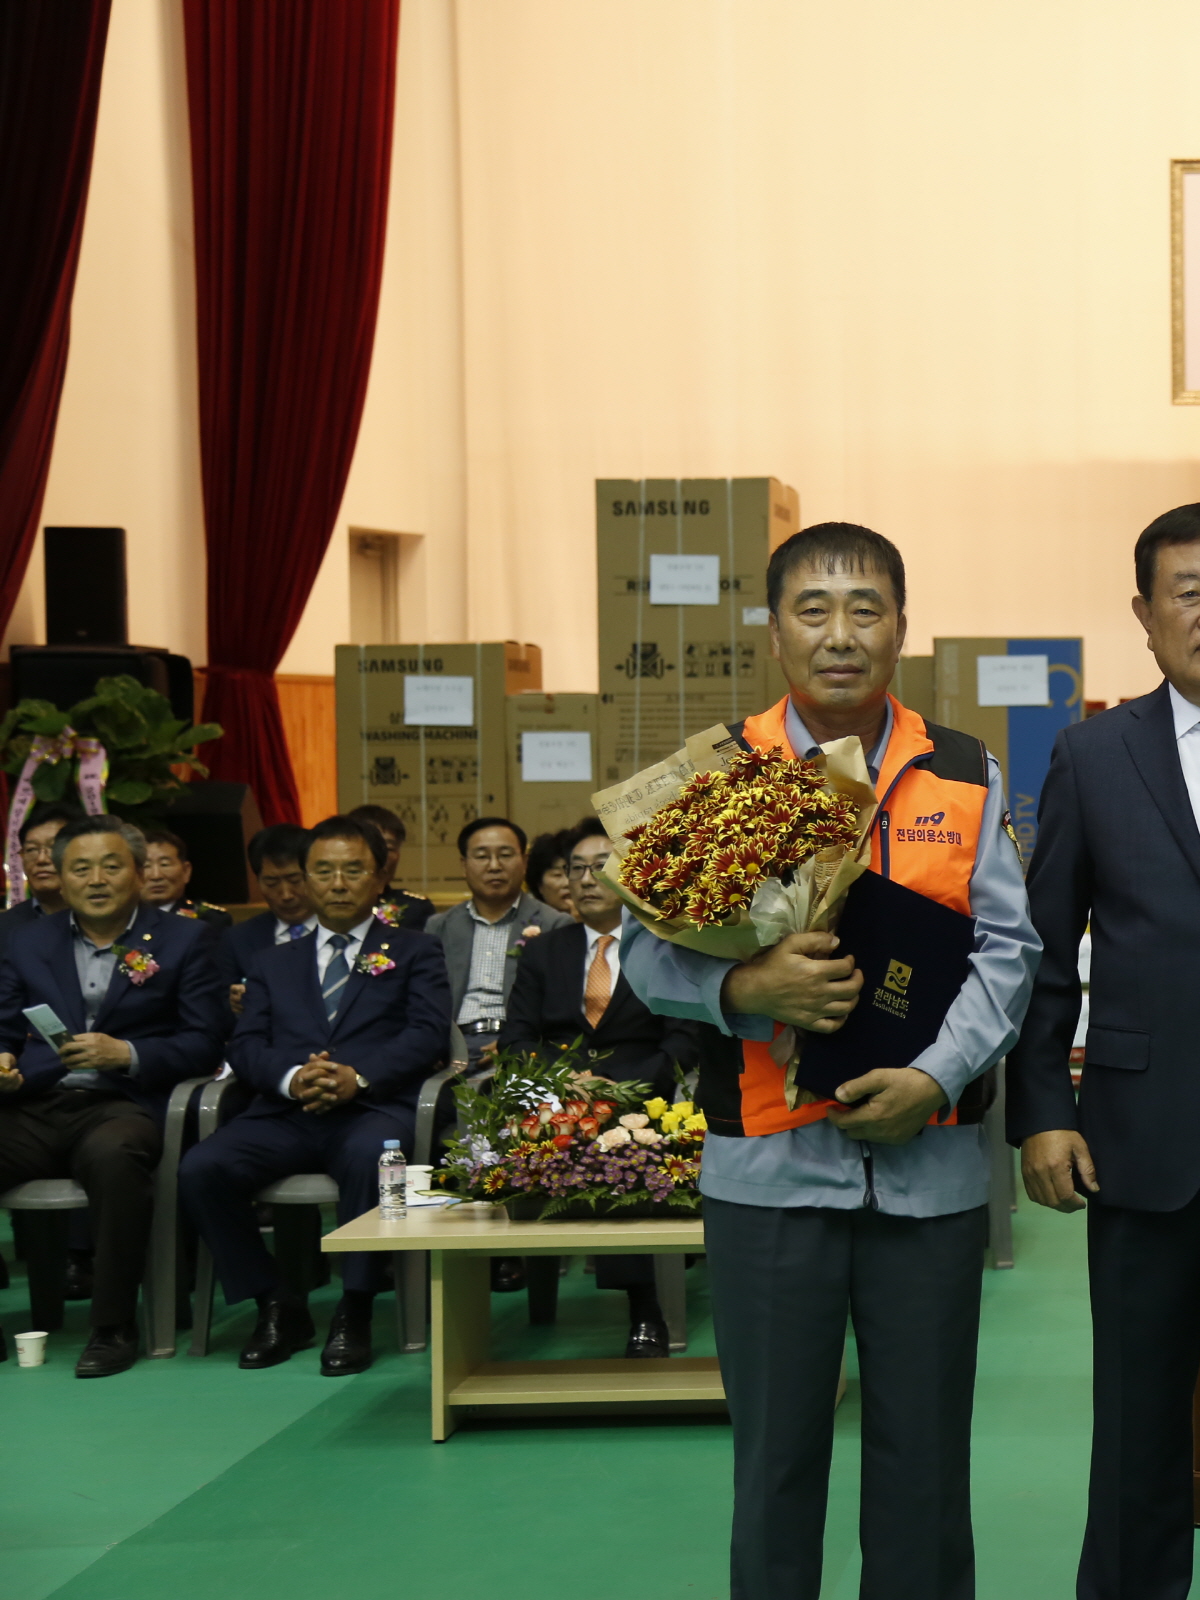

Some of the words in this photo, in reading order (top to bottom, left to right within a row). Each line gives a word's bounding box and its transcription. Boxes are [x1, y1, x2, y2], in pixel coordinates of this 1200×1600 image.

[612, 500, 710, 516] SAMSUNG
[358, 658, 443, 673] SAMSUNG
[360, 729, 420, 742] WASHING
[424, 728, 479, 741] MACHINE
[914, 811, 946, 826] 119
[896, 828, 963, 846] 전담의용소방대
[873, 987, 910, 1012] 전라남도
